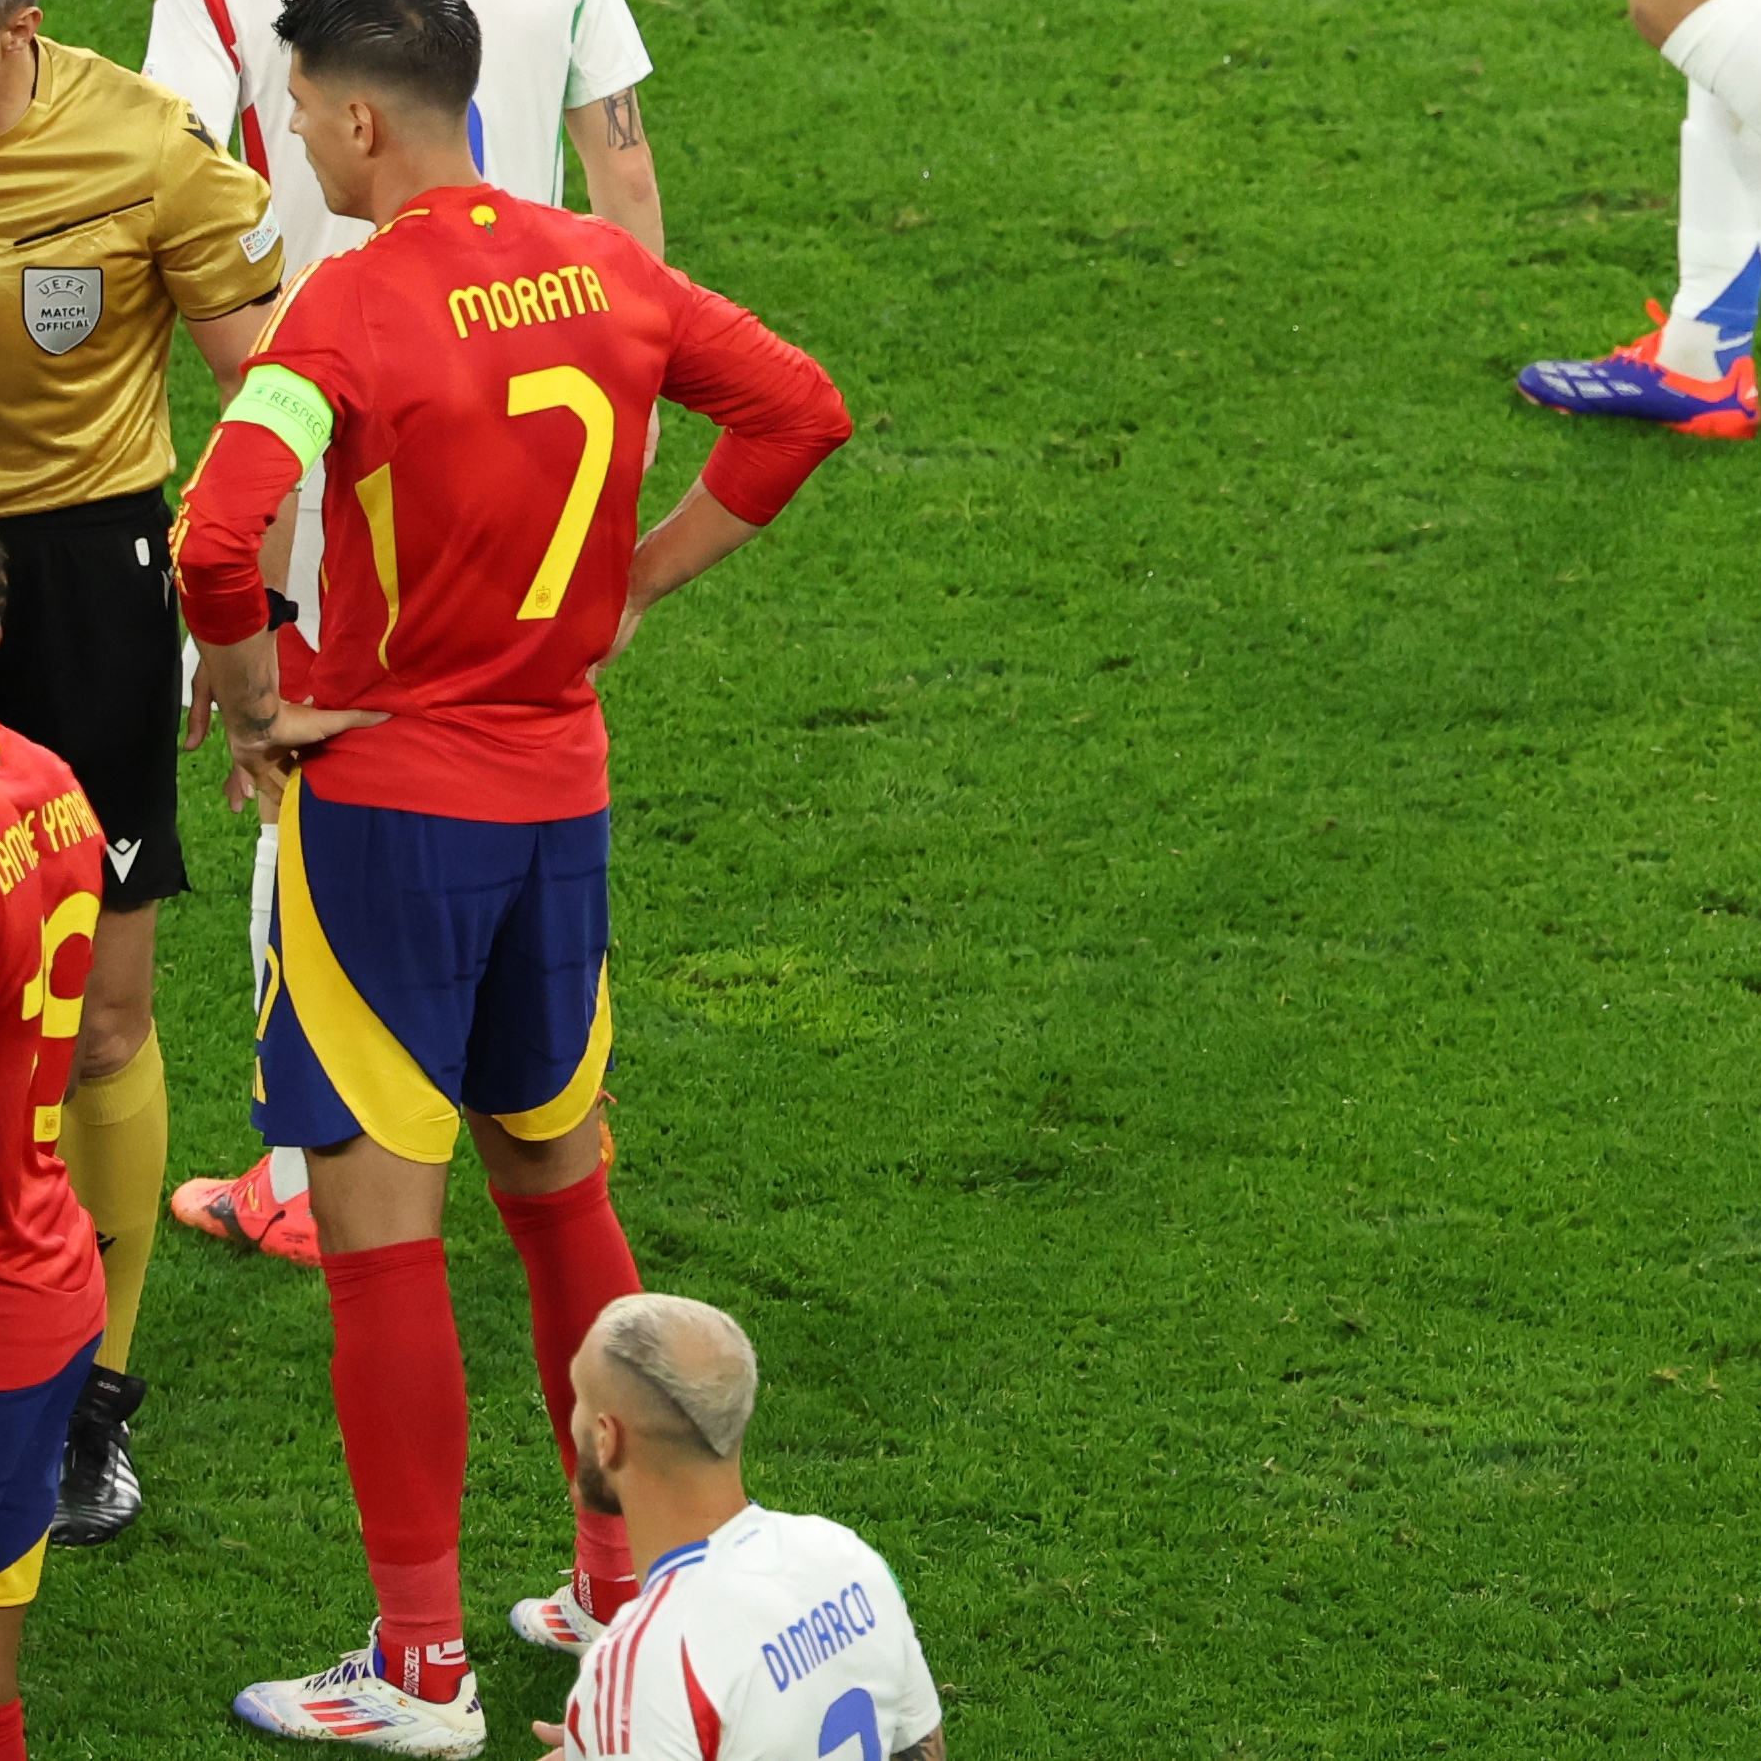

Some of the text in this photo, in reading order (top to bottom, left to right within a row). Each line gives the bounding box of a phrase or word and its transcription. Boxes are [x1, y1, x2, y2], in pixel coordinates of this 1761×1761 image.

[38, 279, 85, 295] UEFA
[40, 306, 85, 318] MATCH
[448, 265, 611, 339] MORATA
[35, 319, 90, 332] OFFICIAL
[269, 391, 325, 441] RESPECT
[507, 365, 614, 620] 7
[761, 1580, 877, 1693] DIMARCO
